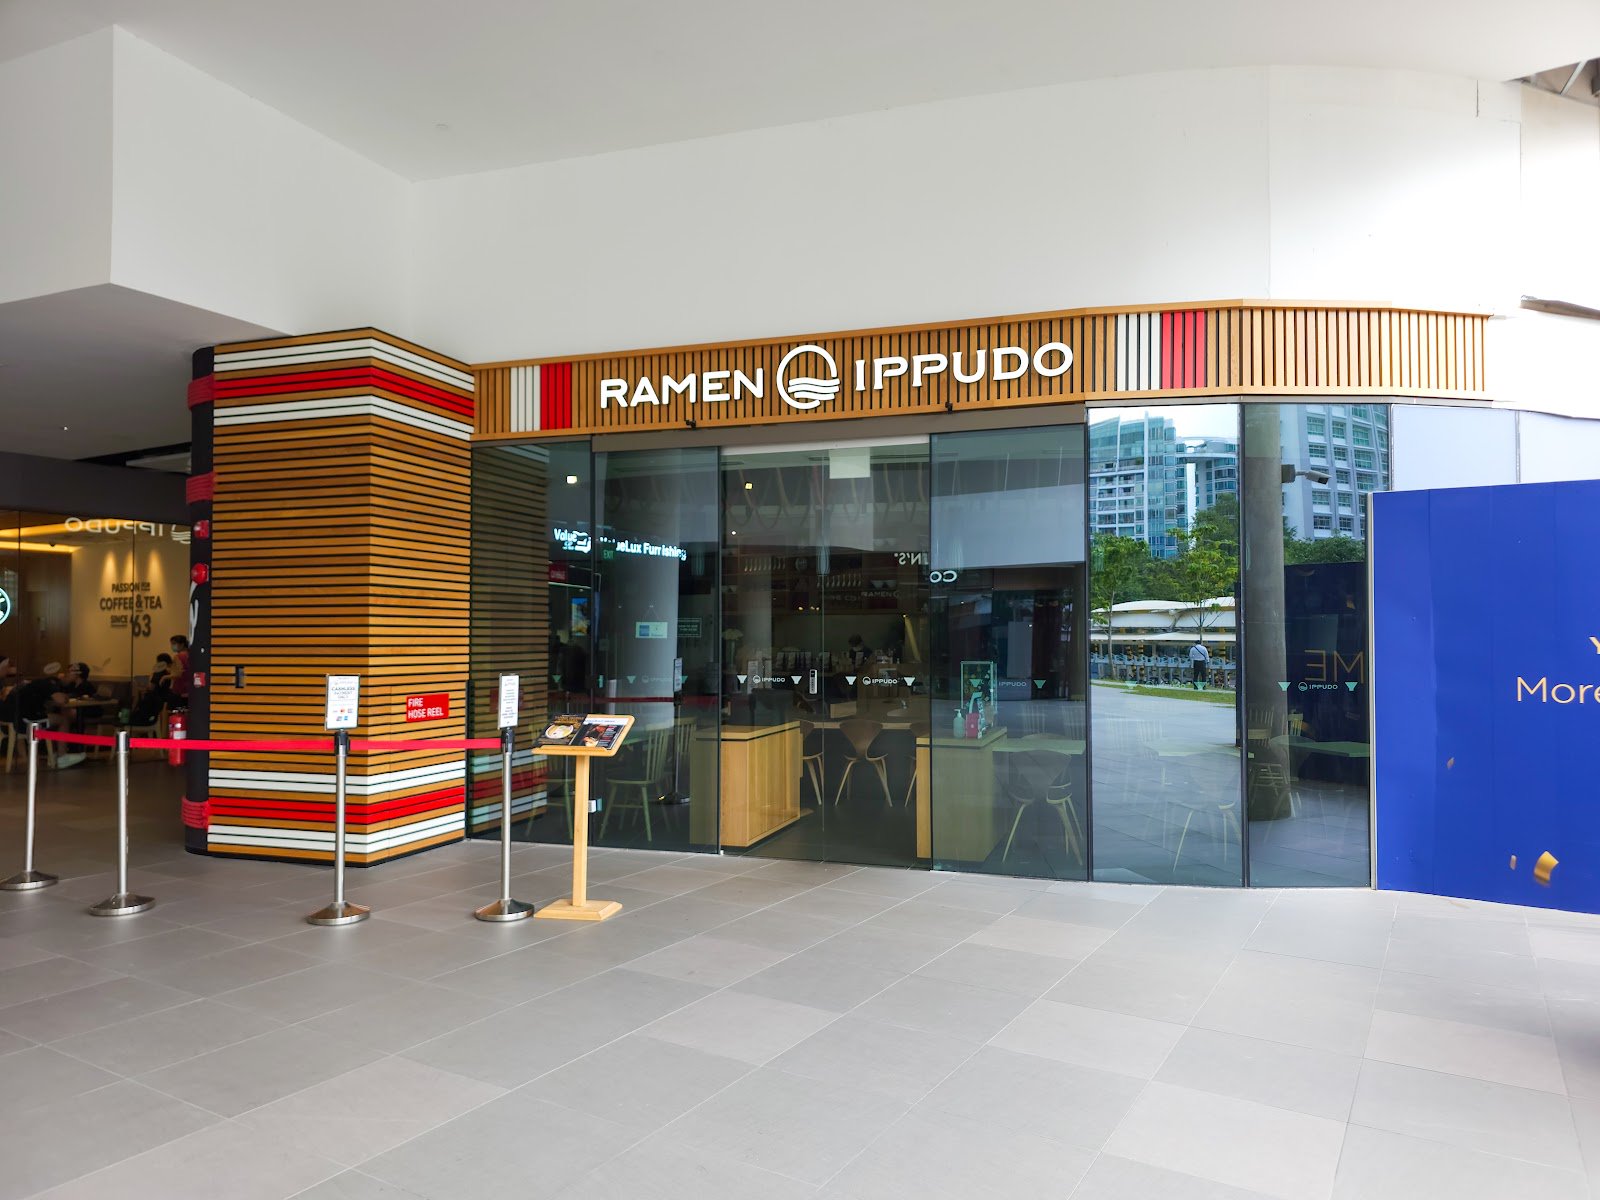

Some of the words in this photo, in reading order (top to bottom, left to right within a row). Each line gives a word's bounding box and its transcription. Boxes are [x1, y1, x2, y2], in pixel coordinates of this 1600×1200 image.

[600, 367, 764, 409] RAMEN
[855, 342, 1074, 391] IPPUDO
[111, 583, 140, 593] PASSION
[99, 596, 134, 611] COFFEE
[135, 594, 143, 610] &
[144, 596, 163, 610] TEA
[110, 615, 128, 624] SINCE
[408, 697, 424, 708] FIRE
[408, 708, 427, 719] HOSE
[427, 706, 444, 717] REEL
